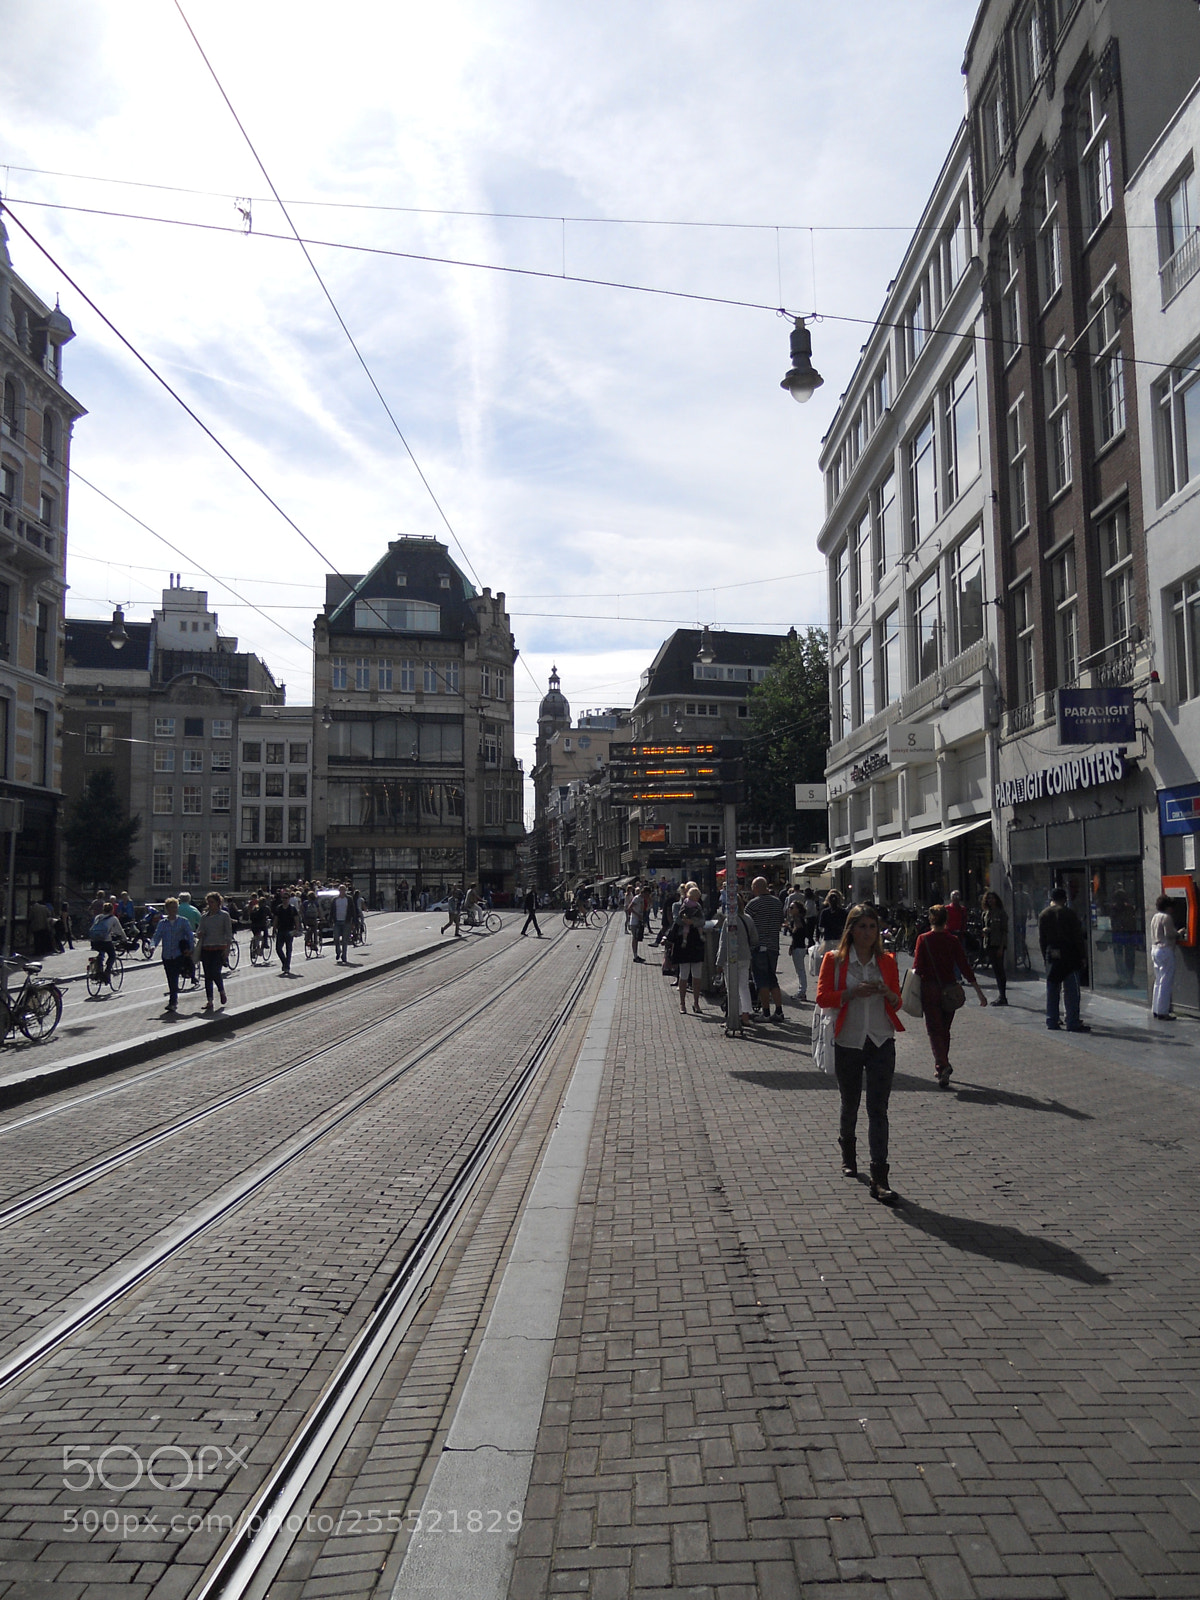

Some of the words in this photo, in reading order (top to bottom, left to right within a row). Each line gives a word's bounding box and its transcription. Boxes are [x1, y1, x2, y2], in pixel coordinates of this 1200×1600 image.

[1064, 705, 1129, 717] PARADIGIT
[1075, 717, 1120, 725] computers
[995, 770, 1043, 809] PARADIGIT
[1046, 747, 1123, 796] COMPUTERS
